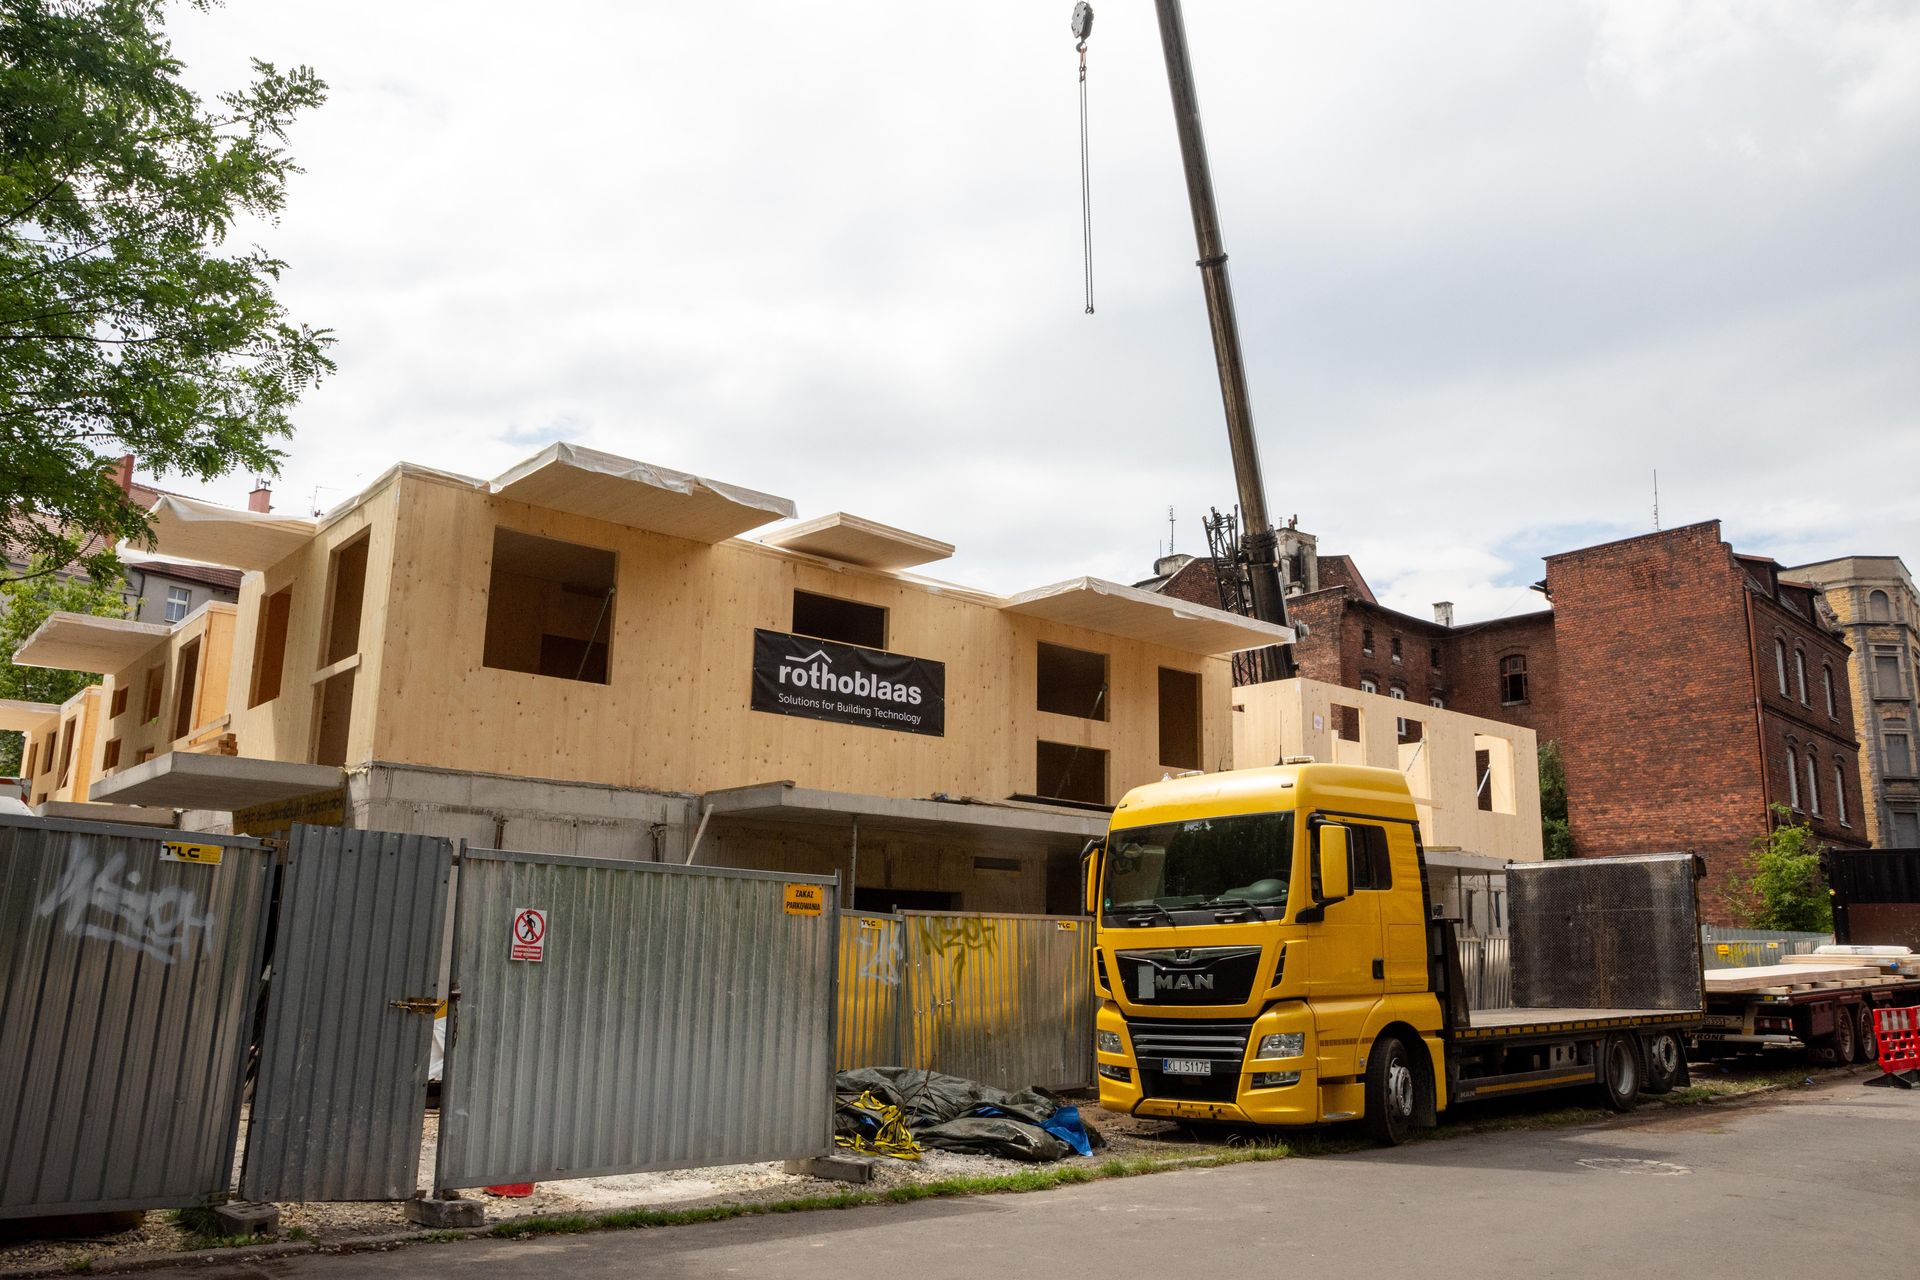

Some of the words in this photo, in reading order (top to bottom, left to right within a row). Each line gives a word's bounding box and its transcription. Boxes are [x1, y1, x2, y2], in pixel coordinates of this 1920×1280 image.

[779, 661, 922, 705] rothoblaas
[778, 693, 820, 709] Solutions
[822, 700, 834, 711] for
[837, 702, 872, 717] Building
[874, 707, 922, 725] Technology
[163, 845, 200, 858] TLC
[796, 890, 814, 898] ZAKAZ
[1155, 974, 1214, 990] MAN
[1690, 1033, 1726, 1041] KRONE
[1185, 1061, 1210, 1073] 5117E
